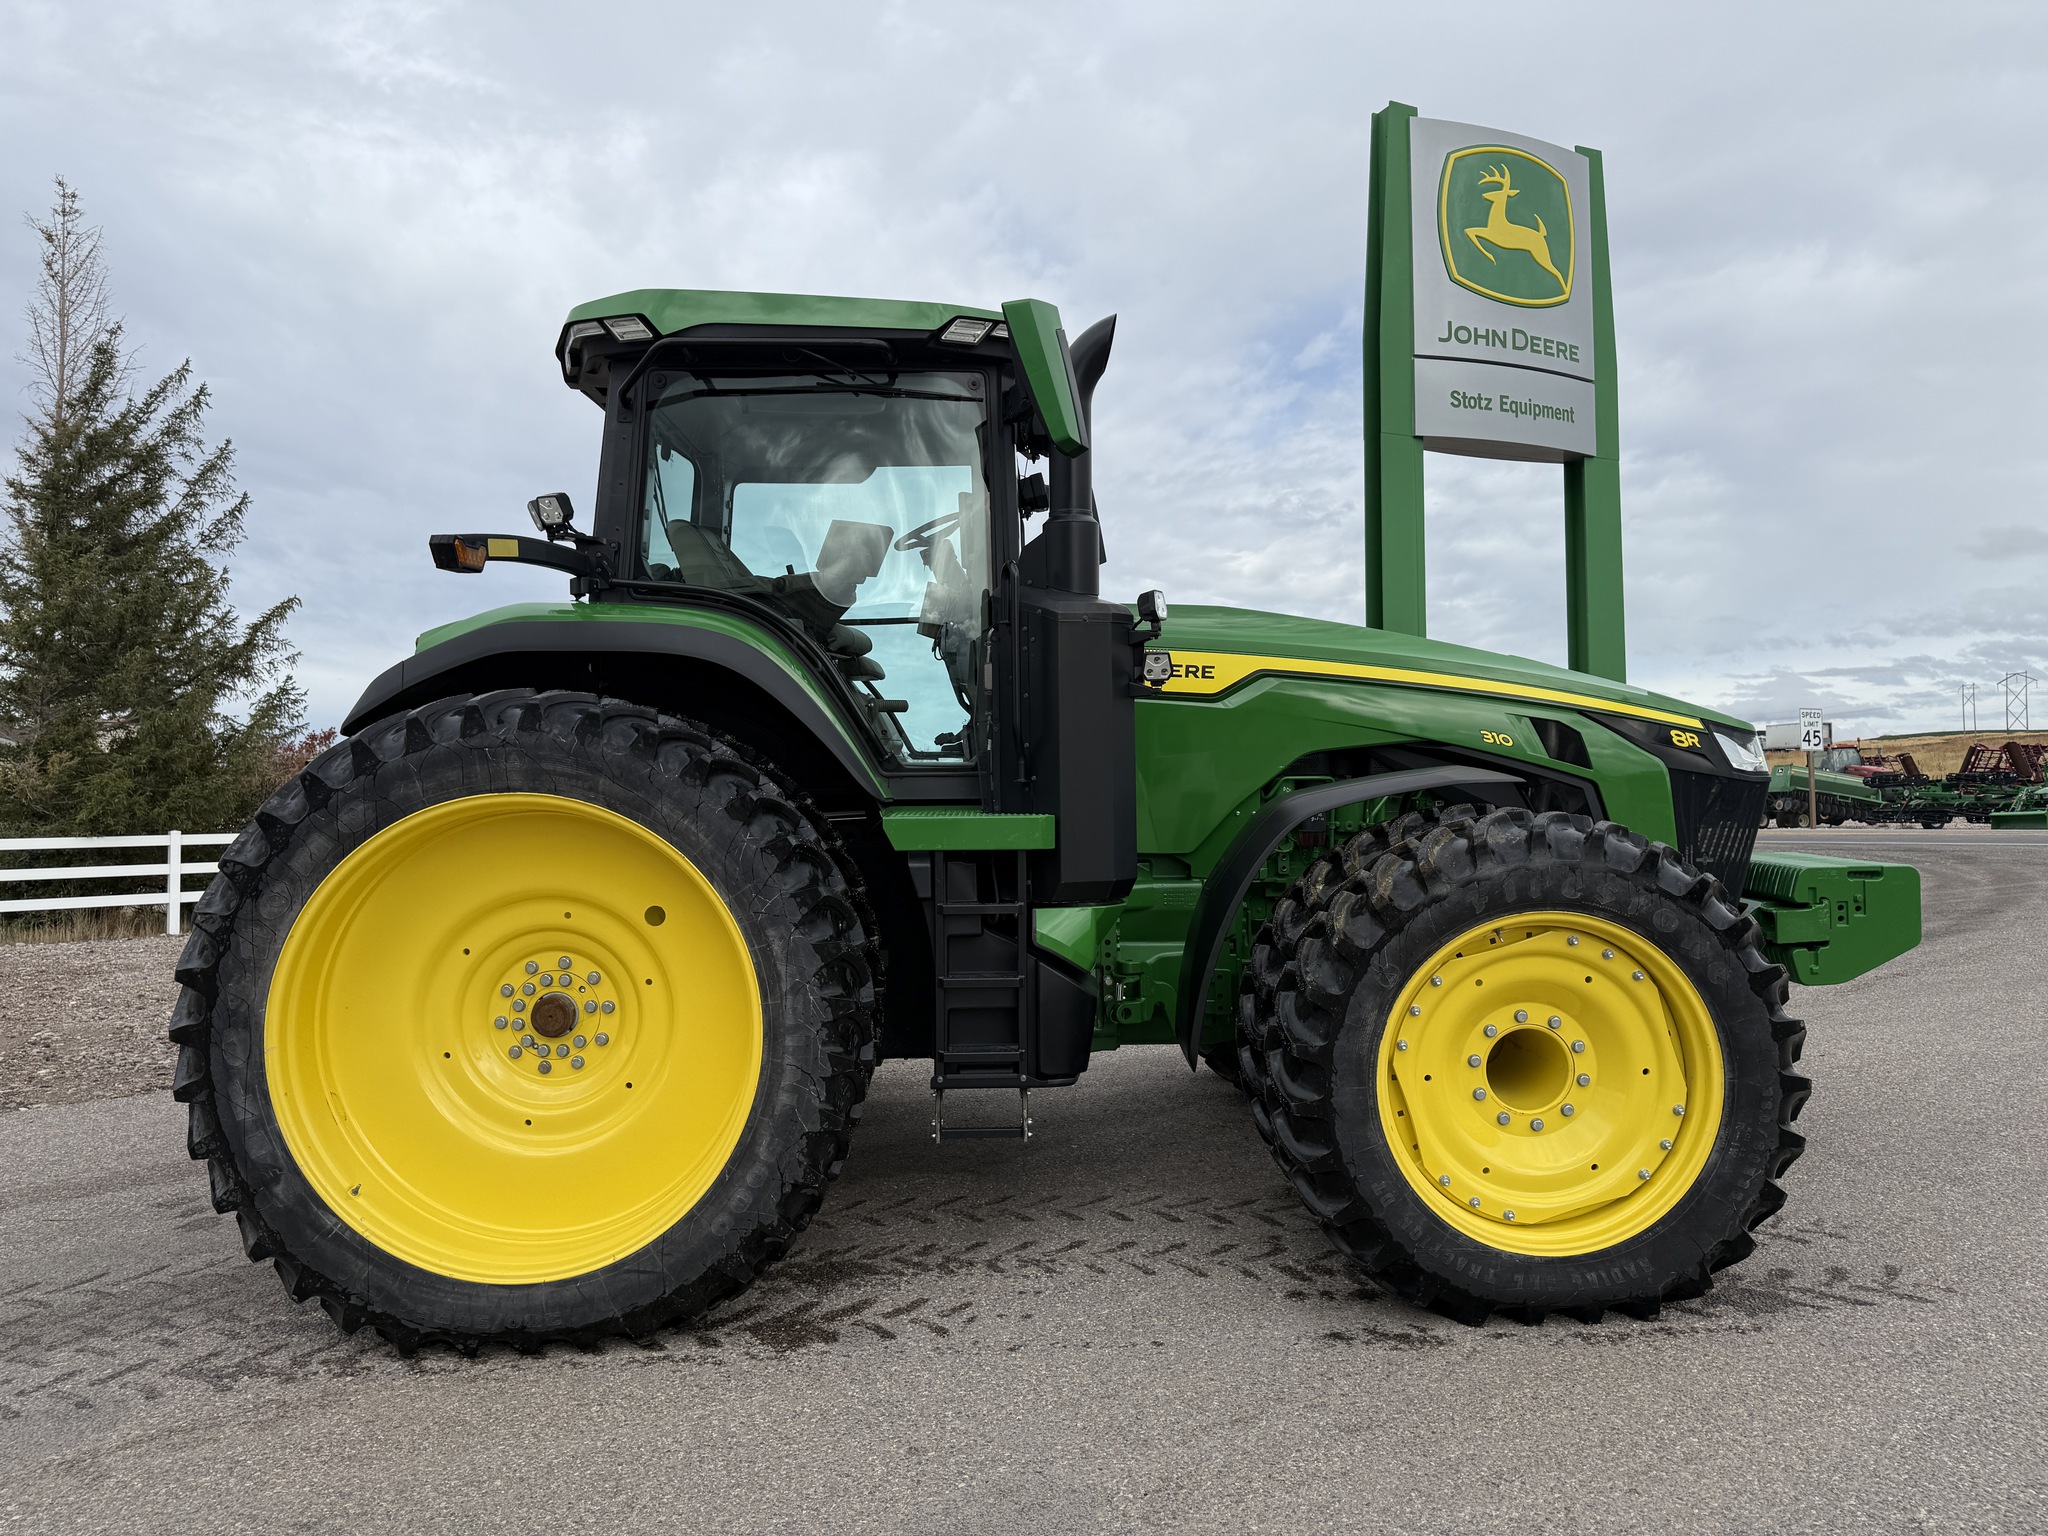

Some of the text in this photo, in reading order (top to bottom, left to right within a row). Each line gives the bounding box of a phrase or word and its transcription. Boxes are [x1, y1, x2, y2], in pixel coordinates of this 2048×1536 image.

[1438, 320, 1580, 363] JOHN DEERE
[1450, 390, 1575, 423] Stotz Equipment
[1171, 664, 1216, 679] ERE
[1801, 711, 1821, 719] SPEED
[1803, 720, 1819, 728] LIMIT
[1480, 730, 1514, 747] 310
[1669, 729, 1702, 748] 8R
[1802, 729, 1821, 747] 45
